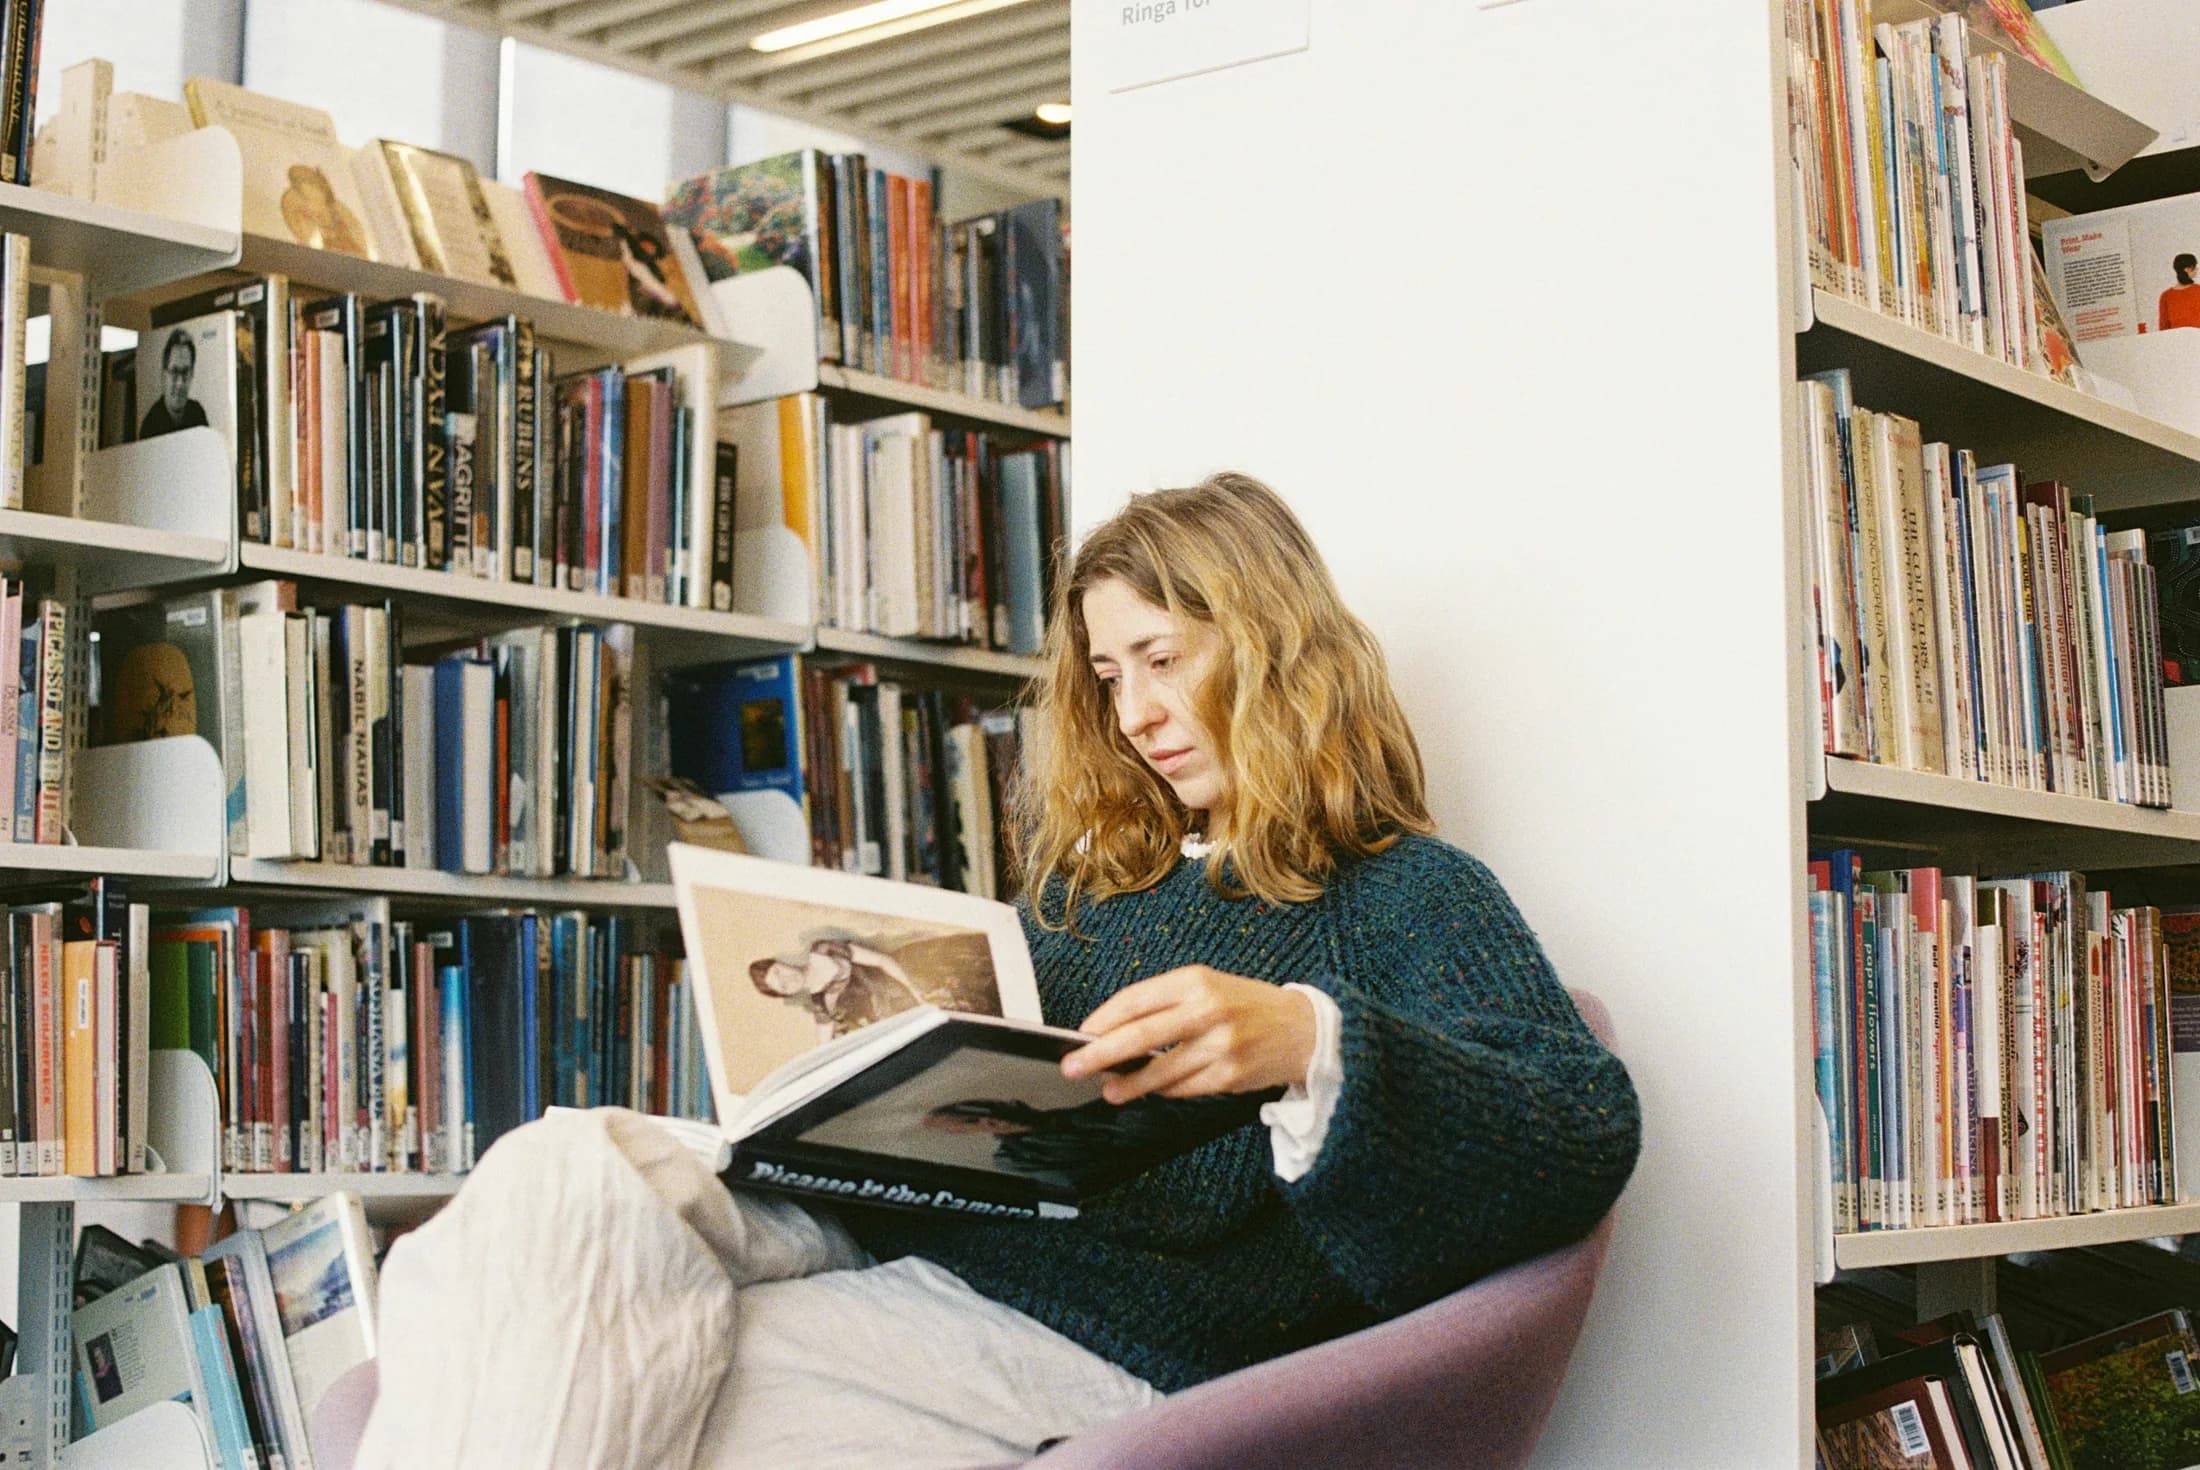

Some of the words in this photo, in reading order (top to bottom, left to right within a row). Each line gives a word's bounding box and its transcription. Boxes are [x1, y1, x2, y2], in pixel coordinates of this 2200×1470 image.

[1122, 0, 1177, 25] Ringa
[427, 326, 447, 427] EYCK
[515, 384, 536, 490] RUBENS
[427, 443, 446, 522] VAN
[452, 436, 475, 547] AGRITT
[1908, 511, 1918, 543] THE
[2047, 520, 2060, 574] Britains
[1866, 528, 1885, 638] ENCYCLOPEDIA
[2020, 552, 2029, 591] MODEL
[47, 617, 65, 701] PICASSO
[354, 659, 367, 724] NABIL
[46, 708, 63, 751] AND
[355, 732, 370, 807] NAHAS
[40, 943, 50, 999] HELENE
[1864, 943, 1873, 997] paper
[1867, 1002, 1877, 1070] flowers
[750, 1161, 857, 1194] Picasso
[883, 1184, 931, 1206] the
[931, 1190, 1035, 1218] Camera
